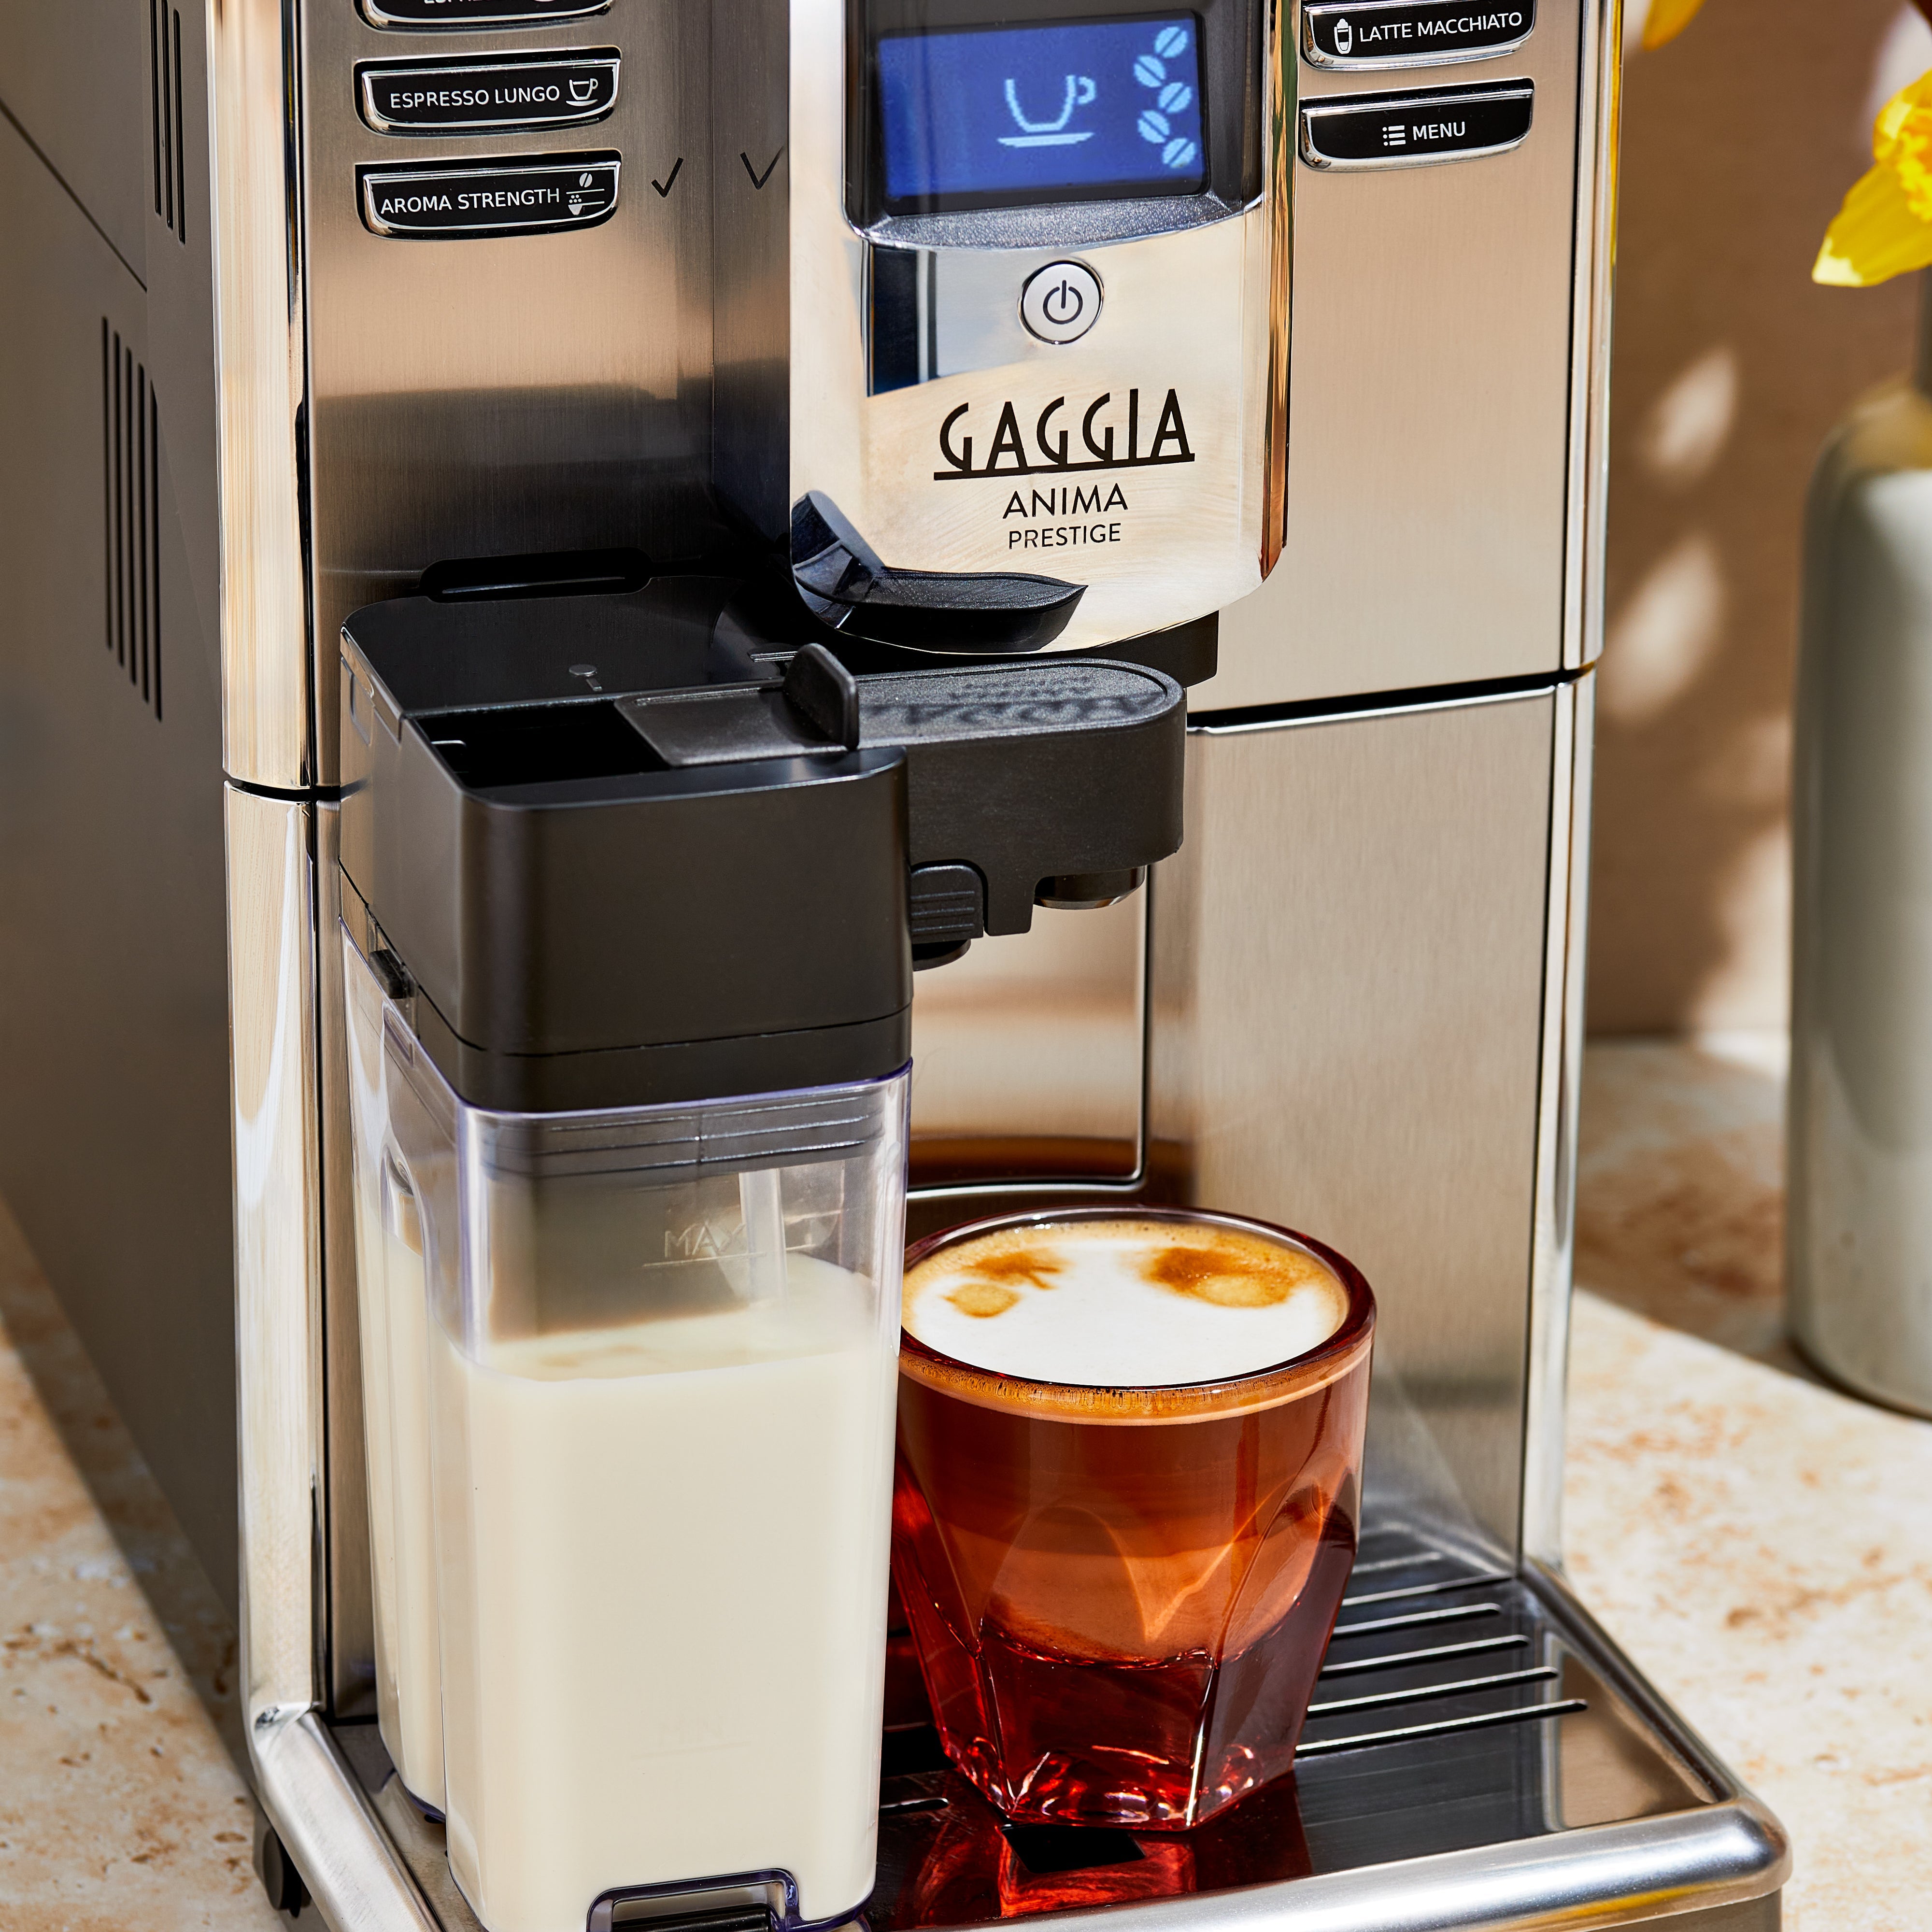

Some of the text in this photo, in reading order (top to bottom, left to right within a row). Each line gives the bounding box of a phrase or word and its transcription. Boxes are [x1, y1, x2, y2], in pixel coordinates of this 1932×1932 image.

[1360, 12, 1522, 43] LATTE MACCHIATO
[390, 85, 560, 108] ESPRESSO LUNGO
[1413, 121, 1465, 141] MENU
[381, 188, 559, 214] AROMA STRENGTH
[935, 388, 1195, 480] GAGGIA
[1002, 483, 1128, 519] ANIMA
[1009, 523, 1121, 550] PRESTIGE
[664, 1220, 747, 1258] MAX
